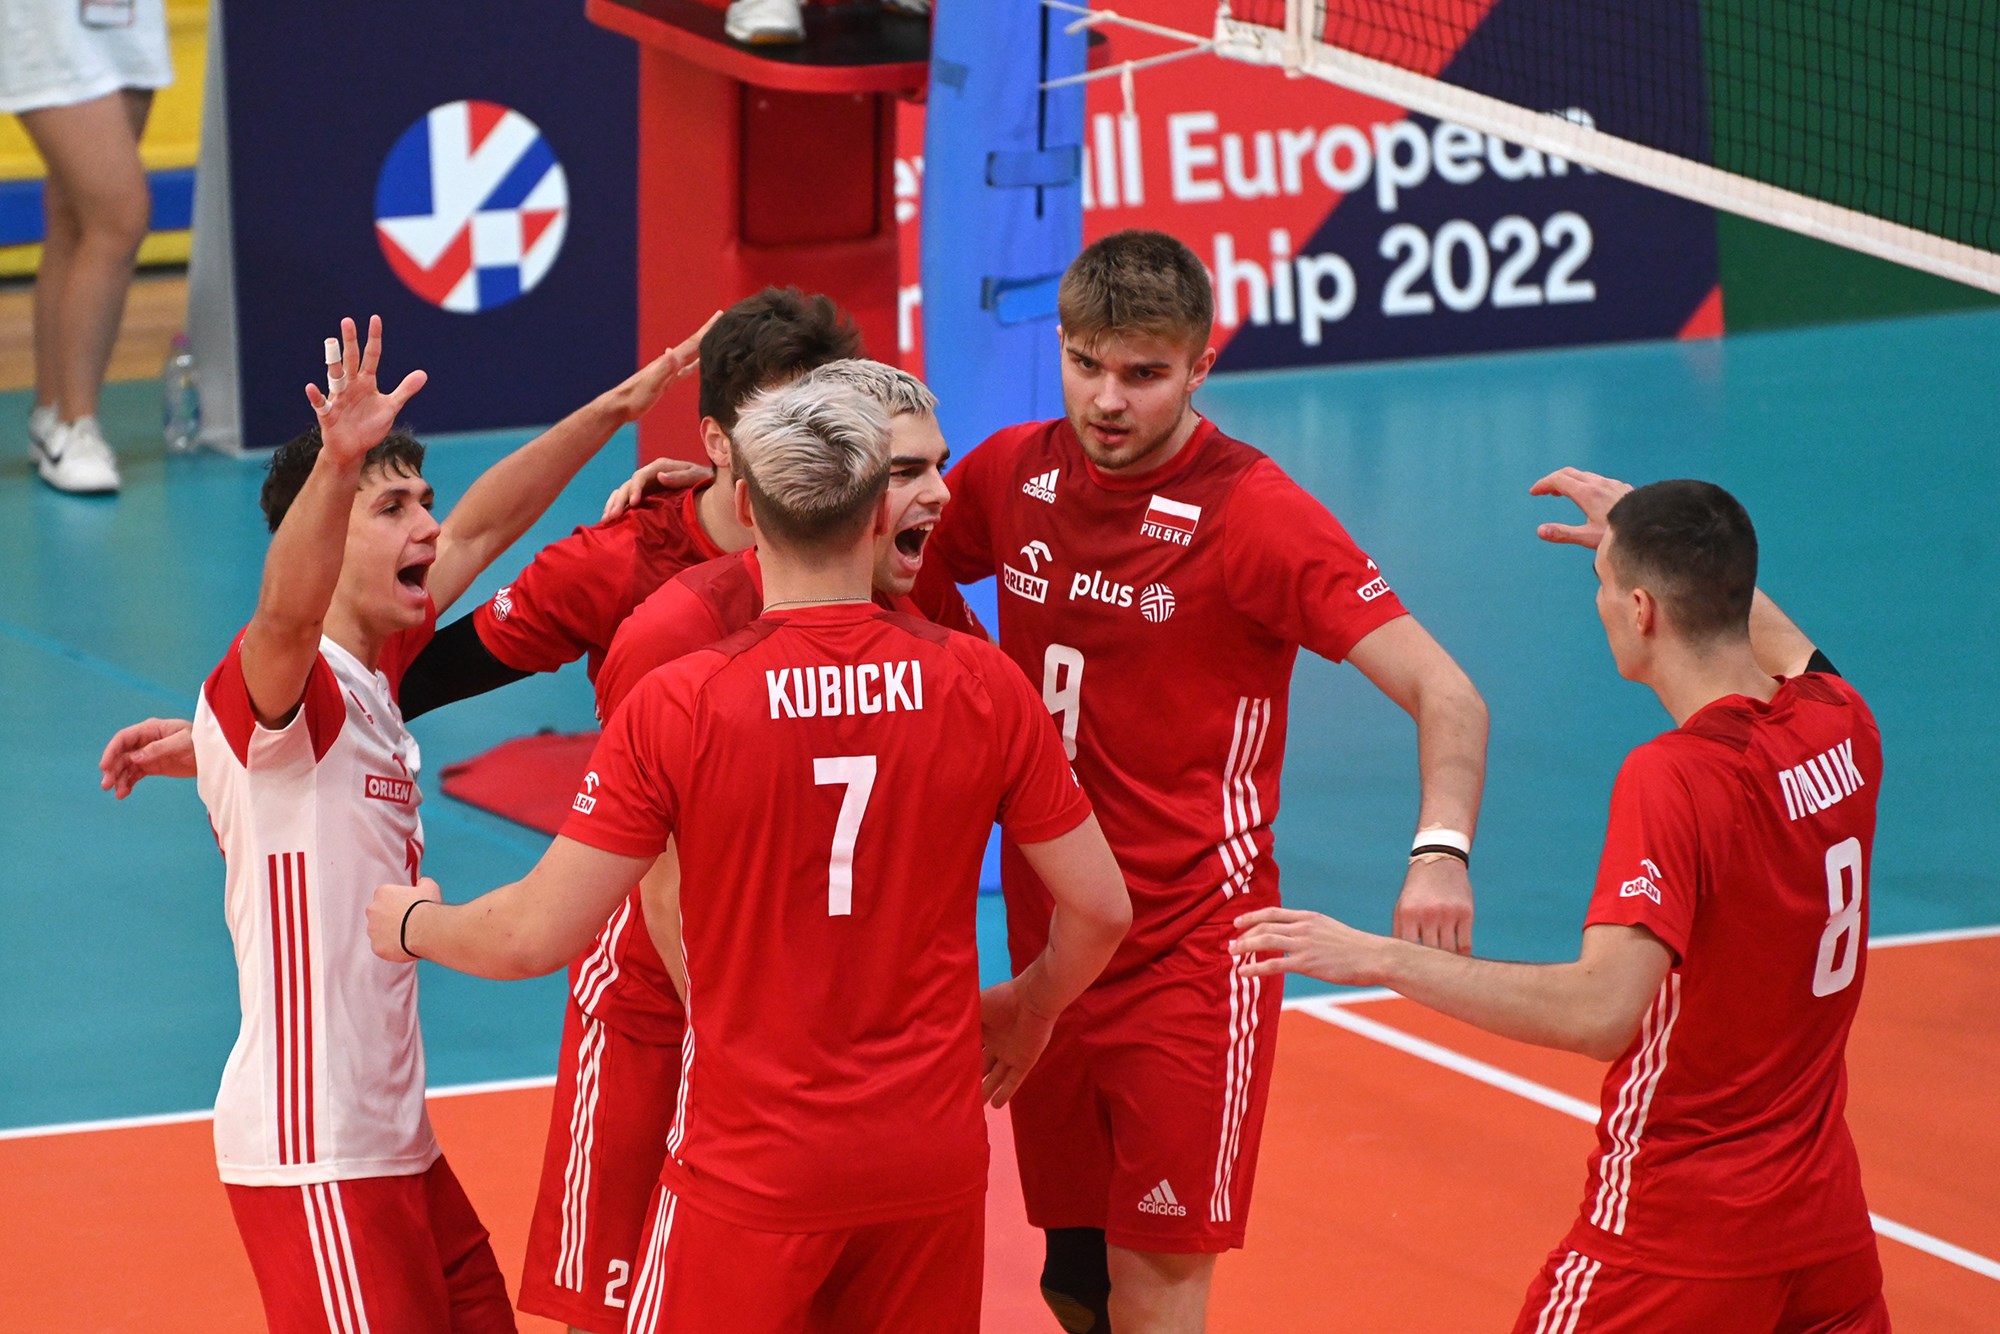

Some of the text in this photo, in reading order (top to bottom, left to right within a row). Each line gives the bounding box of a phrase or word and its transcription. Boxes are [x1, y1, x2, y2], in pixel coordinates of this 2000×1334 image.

[1379, 213, 1596, 316] 2022
[1022, 482, 1056, 504] adidas
[1140, 523, 1192, 546] POLSKA
[1069, 570, 1134, 608] plus
[1362, 578, 1388, 598] ORL
[765, 660, 923, 720] KUBICKI
[1043, 643, 1084, 762] 9
[368, 778, 412, 801] ORLEN
[574, 795, 594, 811] LEN
[813, 755, 877, 917] 7
[1624, 879, 1659, 901] ORLEN
[1812, 836, 1862, 998] 8
[1137, 1201, 1187, 1217] adidas
[604, 1259, 630, 1309] 2
